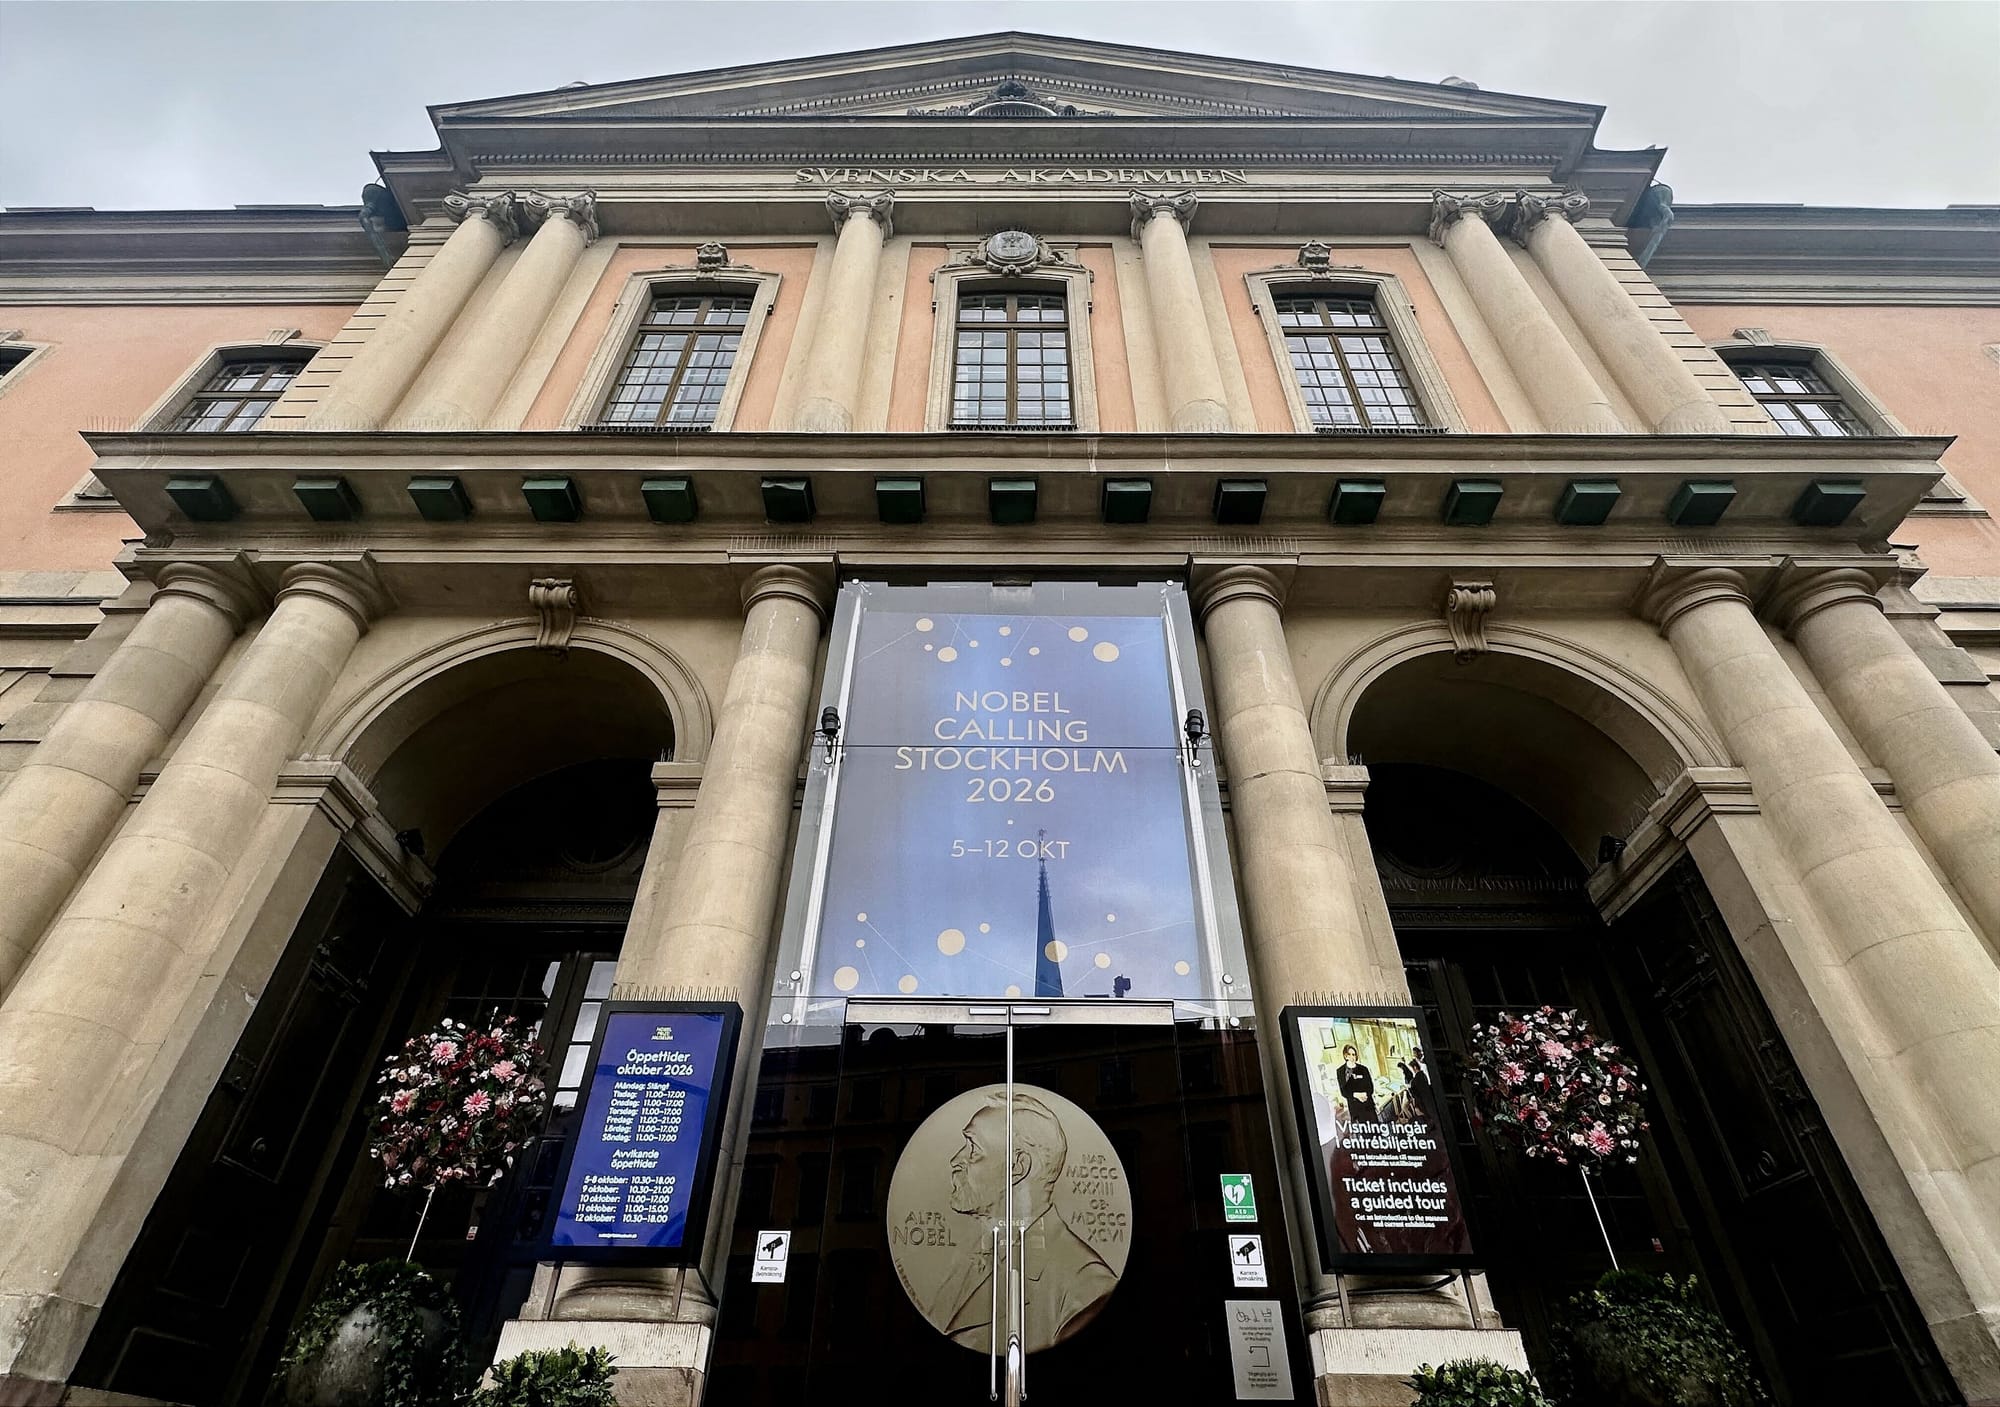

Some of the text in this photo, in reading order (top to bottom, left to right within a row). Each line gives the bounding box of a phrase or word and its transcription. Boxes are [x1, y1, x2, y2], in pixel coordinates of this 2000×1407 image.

[795, 168, 1248, 183] SVENSKA AKADEMIEN
[955, 691, 1069, 713] NOBEL
[934, 718, 1088, 742] CALLING
[894, 746, 1128, 773] STOCKHOLM
[966, 778, 1055, 802] 2026
[1017, 839, 1070, 859] OKT
[626, 1048, 691, 1064] Öppettider
[616, 1063, 694, 1076] oktober 2026
[1335, 1120, 1428, 1137] Visning ingår
[1342, 1135, 1437, 1152] entrébiljetten
[612, 1149, 659, 1158] Avvikande
[610, 1159, 658, 1170] öppettider
[1066, 1165, 1118, 1179] MDCCC
[1072, 1180, 1114, 1196] XXXIII
[1342, 1178, 1447, 1193] Ticket includes
[580, 1194, 589, 1202] 10
[1350, 1194, 1447, 1212] a guided tour
[577, 1204, 585, 1212] 11
[575, 1213, 584, 1222] 12
[1070, 1211, 1127, 1226] MDCCC
[893, 1226, 957, 1247] NOBEL
[1087, 1228, 1124, 1243] XCVI
